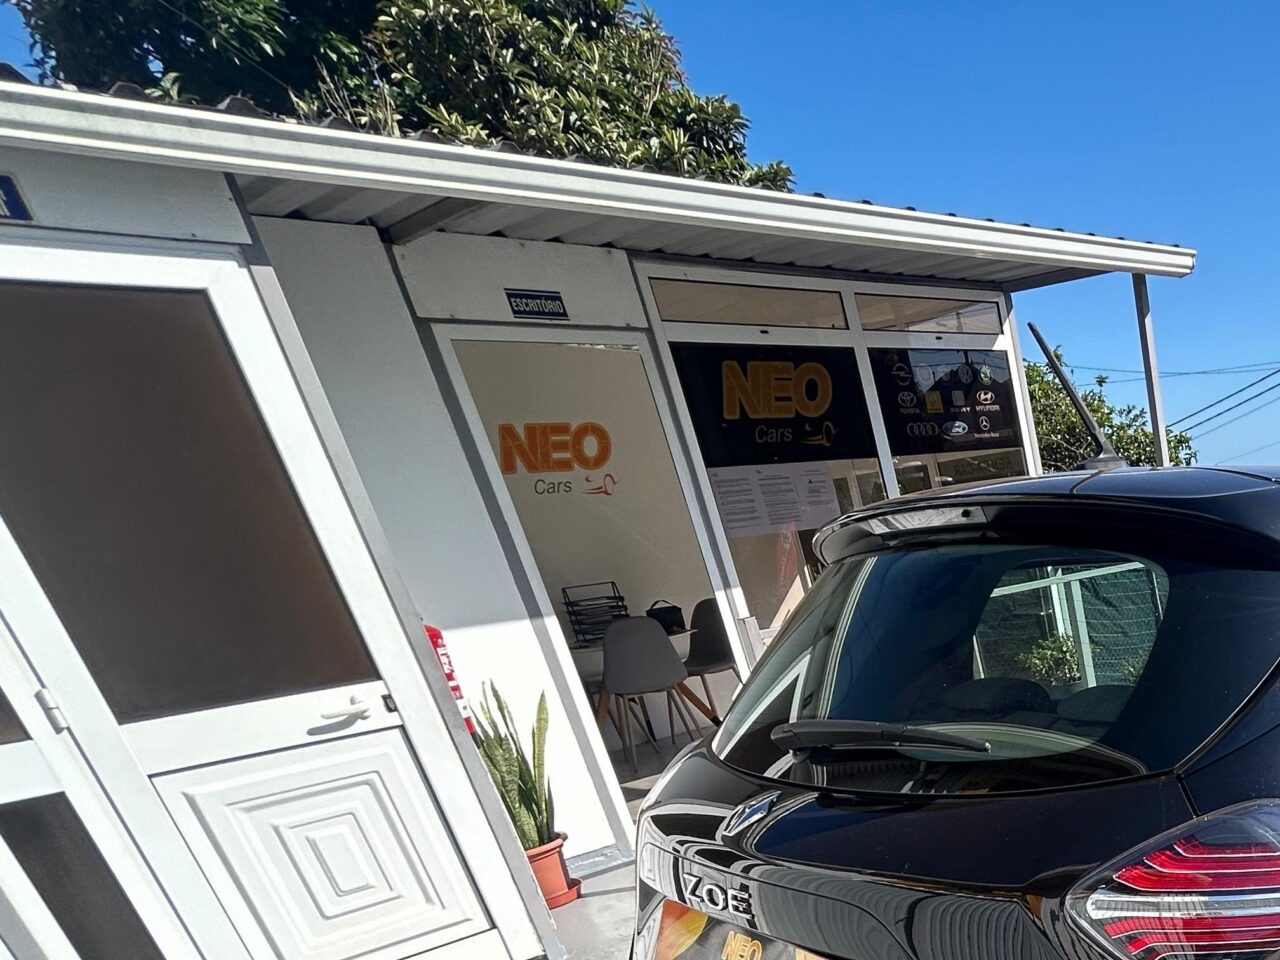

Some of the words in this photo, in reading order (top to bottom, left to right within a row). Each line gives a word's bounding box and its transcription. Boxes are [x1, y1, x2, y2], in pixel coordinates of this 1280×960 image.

[510, 297, 564, 313] ESCRITÓRIO
[722, 360, 833, 420] NEO
[498, 421, 613, 475] NEO
[755, 424, 793, 444] Cars
[534, 478, 572, 495] Cars
[683, 872, 755, 920] ZOE
